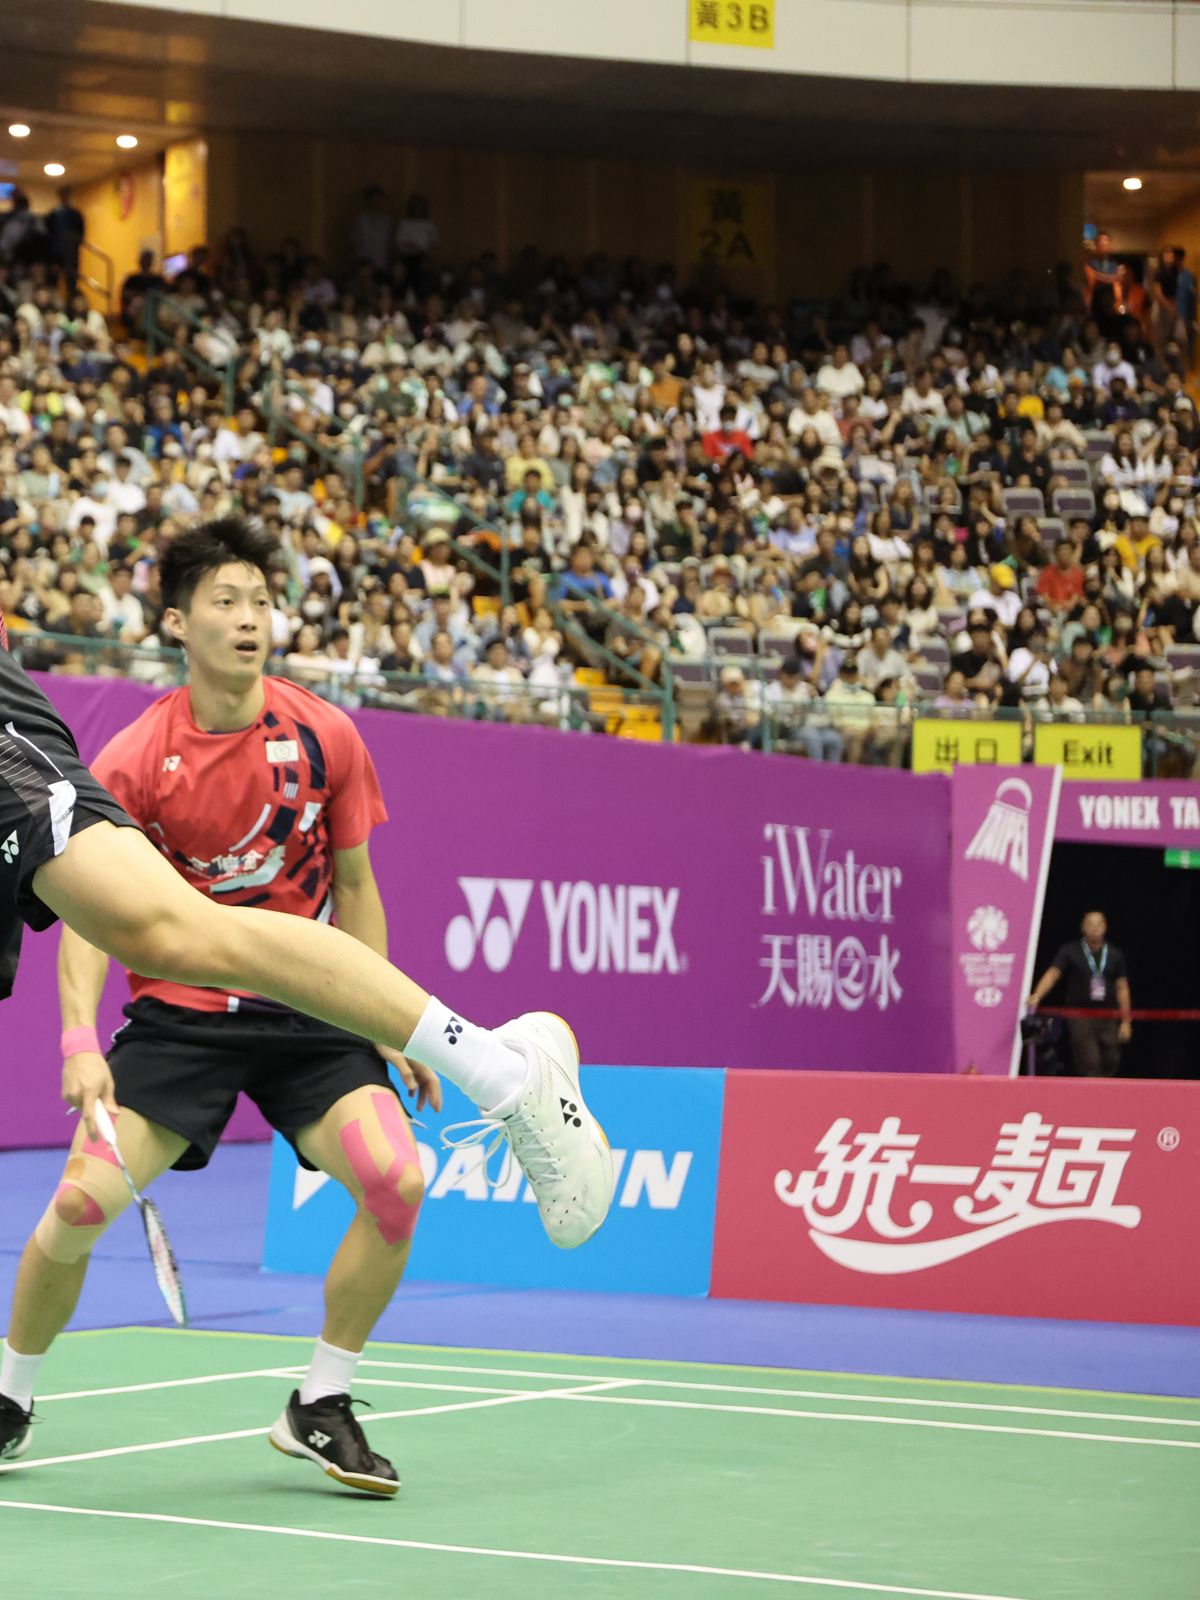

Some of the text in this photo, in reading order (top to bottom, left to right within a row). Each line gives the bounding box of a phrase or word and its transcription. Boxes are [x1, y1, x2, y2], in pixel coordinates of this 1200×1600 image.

[935, 736, 998, 763] 出口
[1062, 739, 1113, 767] Exit
[1079, 795, 1161, 830] YONEX
[760, 822, 902, 924] iWater
[540, 879, 681, 975] YONEX
[774, 1111, 1142, 1275] 統一麵
